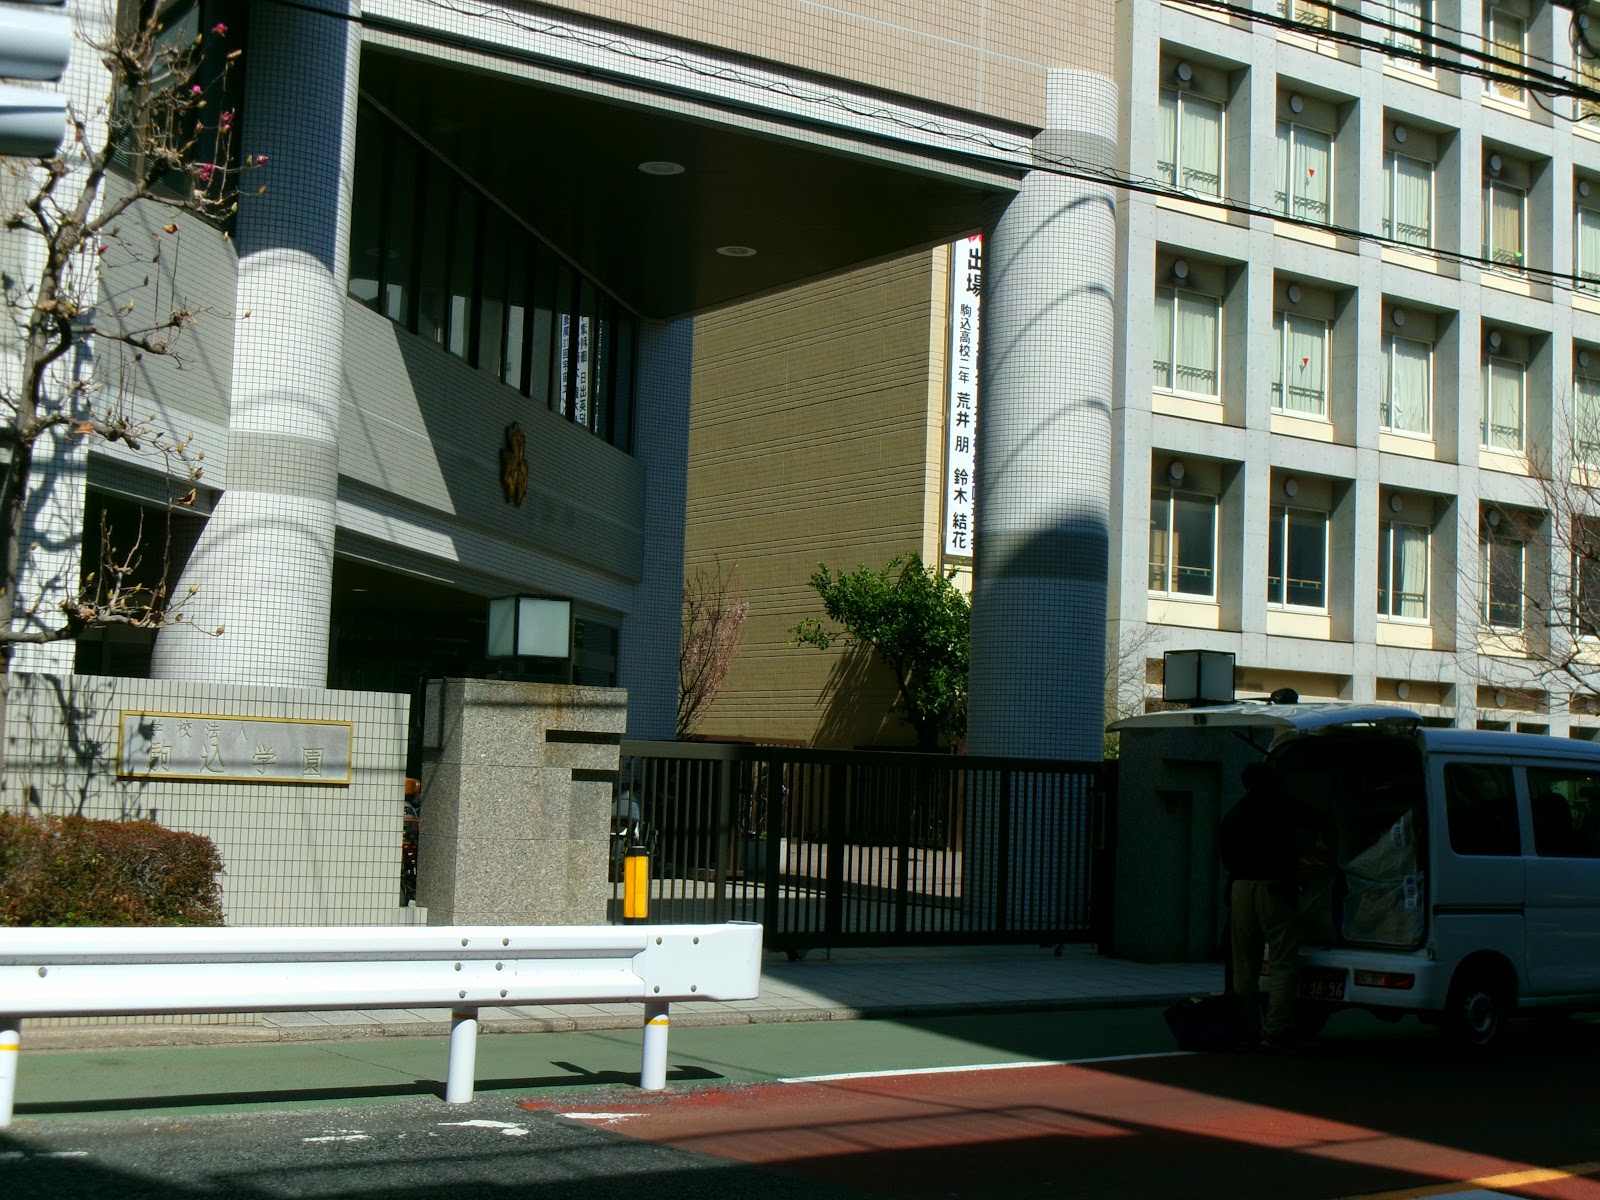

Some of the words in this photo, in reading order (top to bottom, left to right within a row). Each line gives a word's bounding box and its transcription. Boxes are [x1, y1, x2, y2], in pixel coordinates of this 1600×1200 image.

[966, 234, 982, 298] 出場
[958, 303, 972, 384] 駒込高校二年
[956, 391, 971, 428] 荒井
[954, 435, 969, 454] 朋
[953, 467, 969, 505] 鈴木
[952, 511, 968, 549] 結花
[148, 718, 250, 741] 学校法人
[147, 739, 324, 778] 駒込学園
